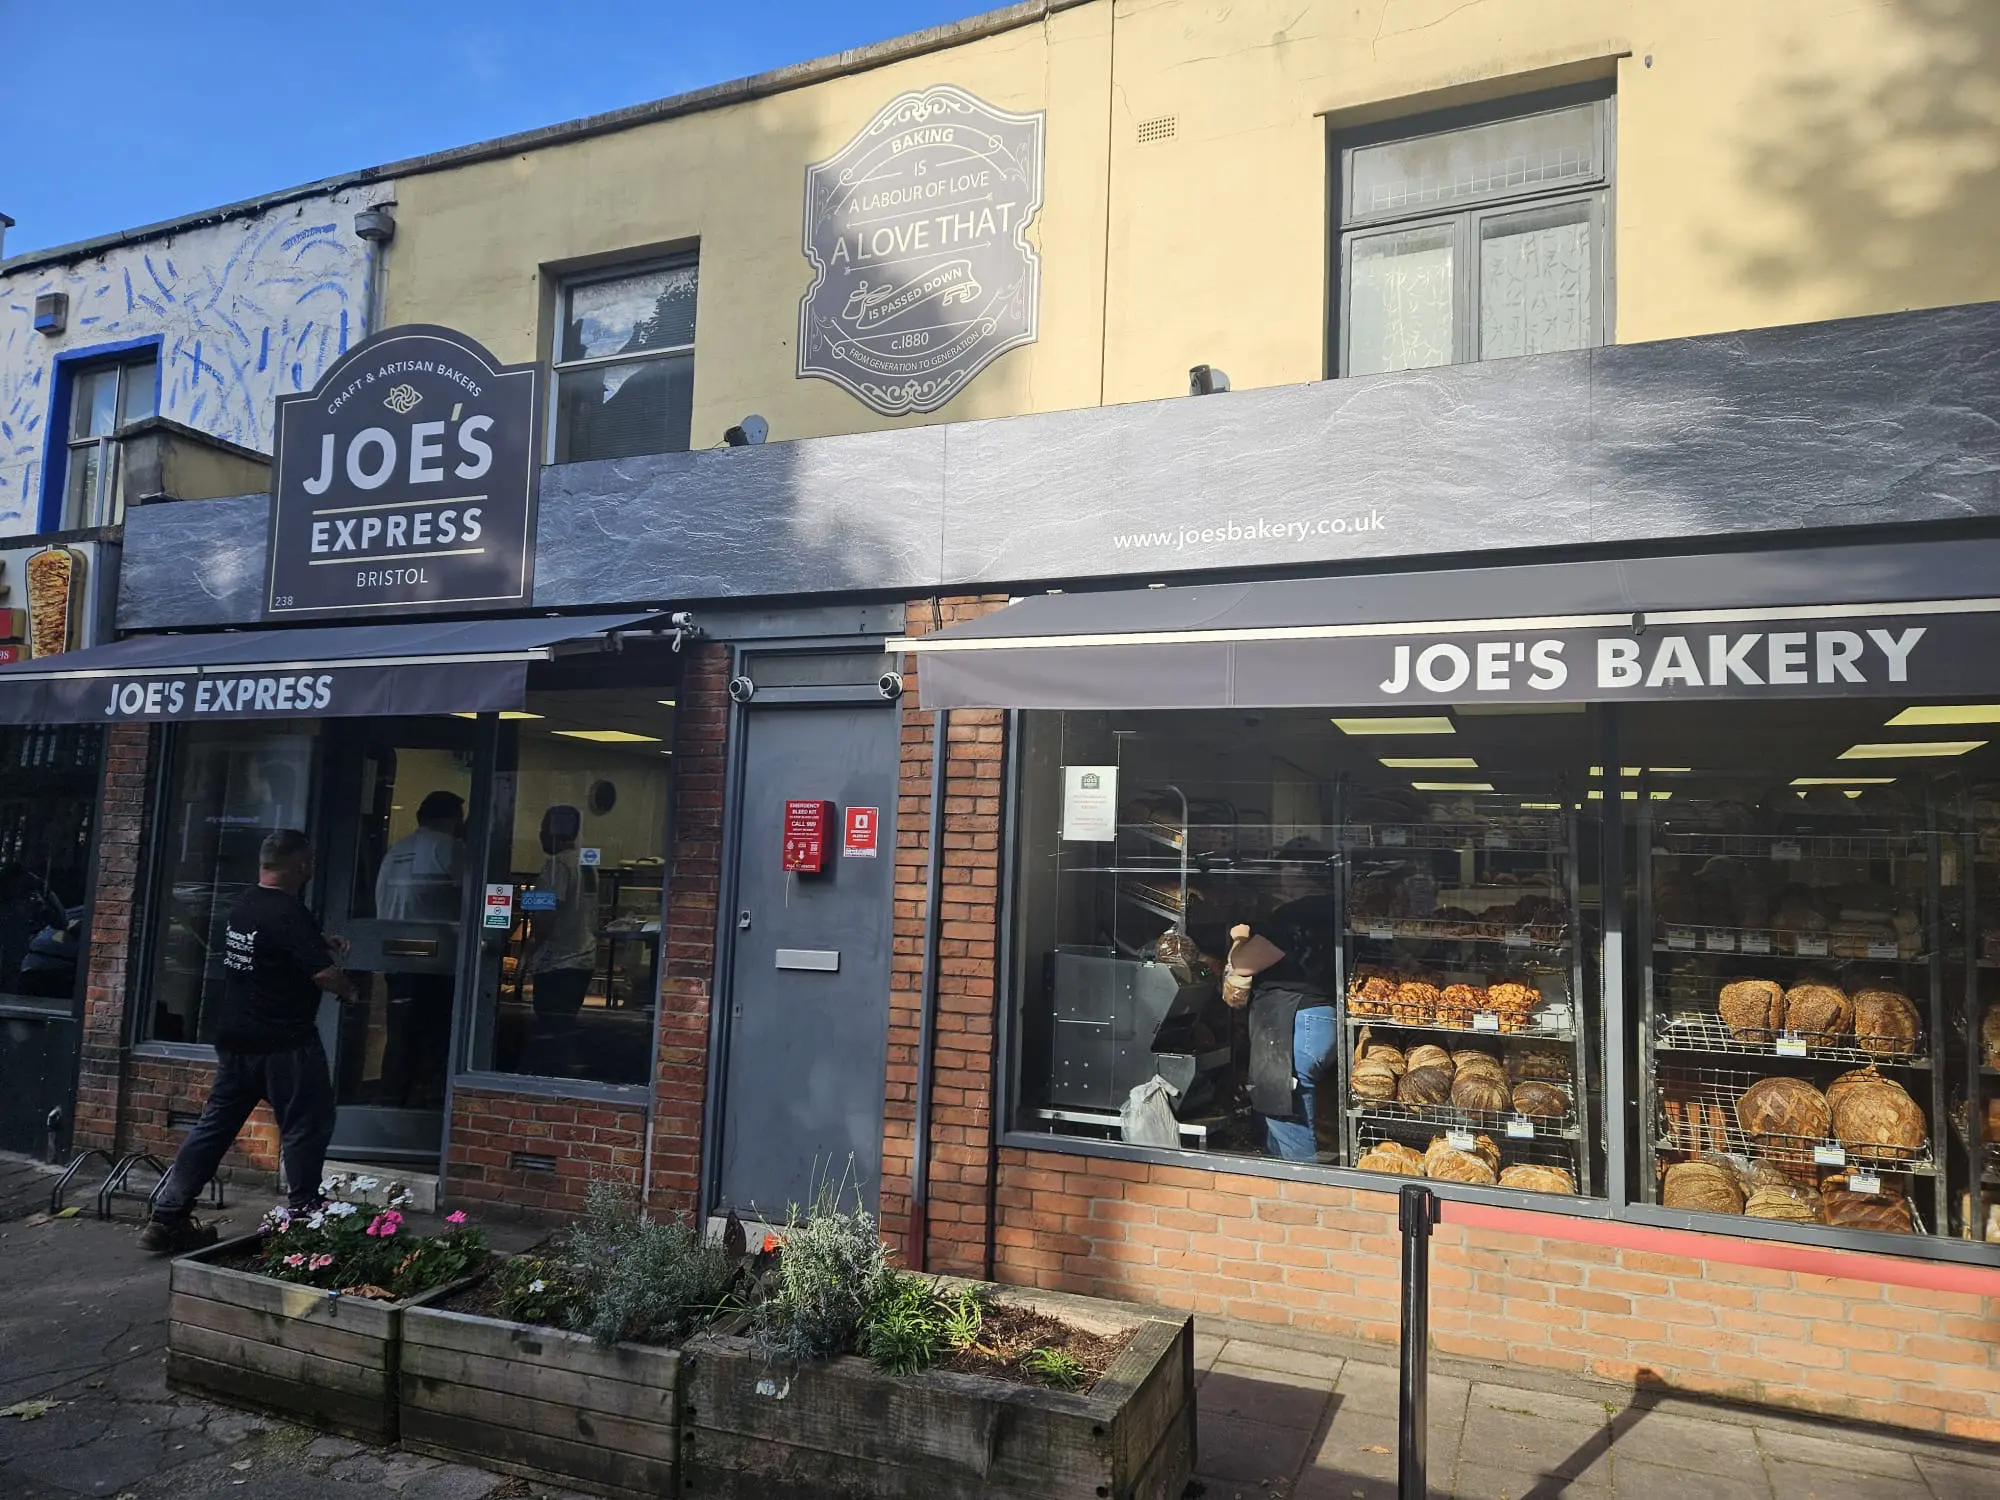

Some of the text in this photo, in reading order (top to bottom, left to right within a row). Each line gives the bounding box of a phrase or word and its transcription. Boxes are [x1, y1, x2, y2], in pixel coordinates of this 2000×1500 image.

[891, 128, 954, 154] BAKING
[914, 160, 927, 176] IS
[849, 170, 989, 214] A LABOUR OF LOVE
[830, 202, 1016, 265] A LOVE THAT
[868, 267, 962, 320] IS PASSED DOWN
[849, 332, 979, 372] FROM GENERATION TO GENERATION
[891, 332, 929, 350] c.1880
[327, 360, 482, 415] CRAFT & ARTISAN BAKERS
[302, 403, 495, 496] JOE'S
[311, 507, 483, 553] EXPRESS
[1113, 510, 1386, 551] www.joesbakery.co.uk
[356, 568, 429, 588] BRISTOL
[275, 595, 294, 607] 238
[1379, 628, 1928, 695] JOE'S BAKERY
[104, 674, 334, 716] JOE'S EXPRESS
